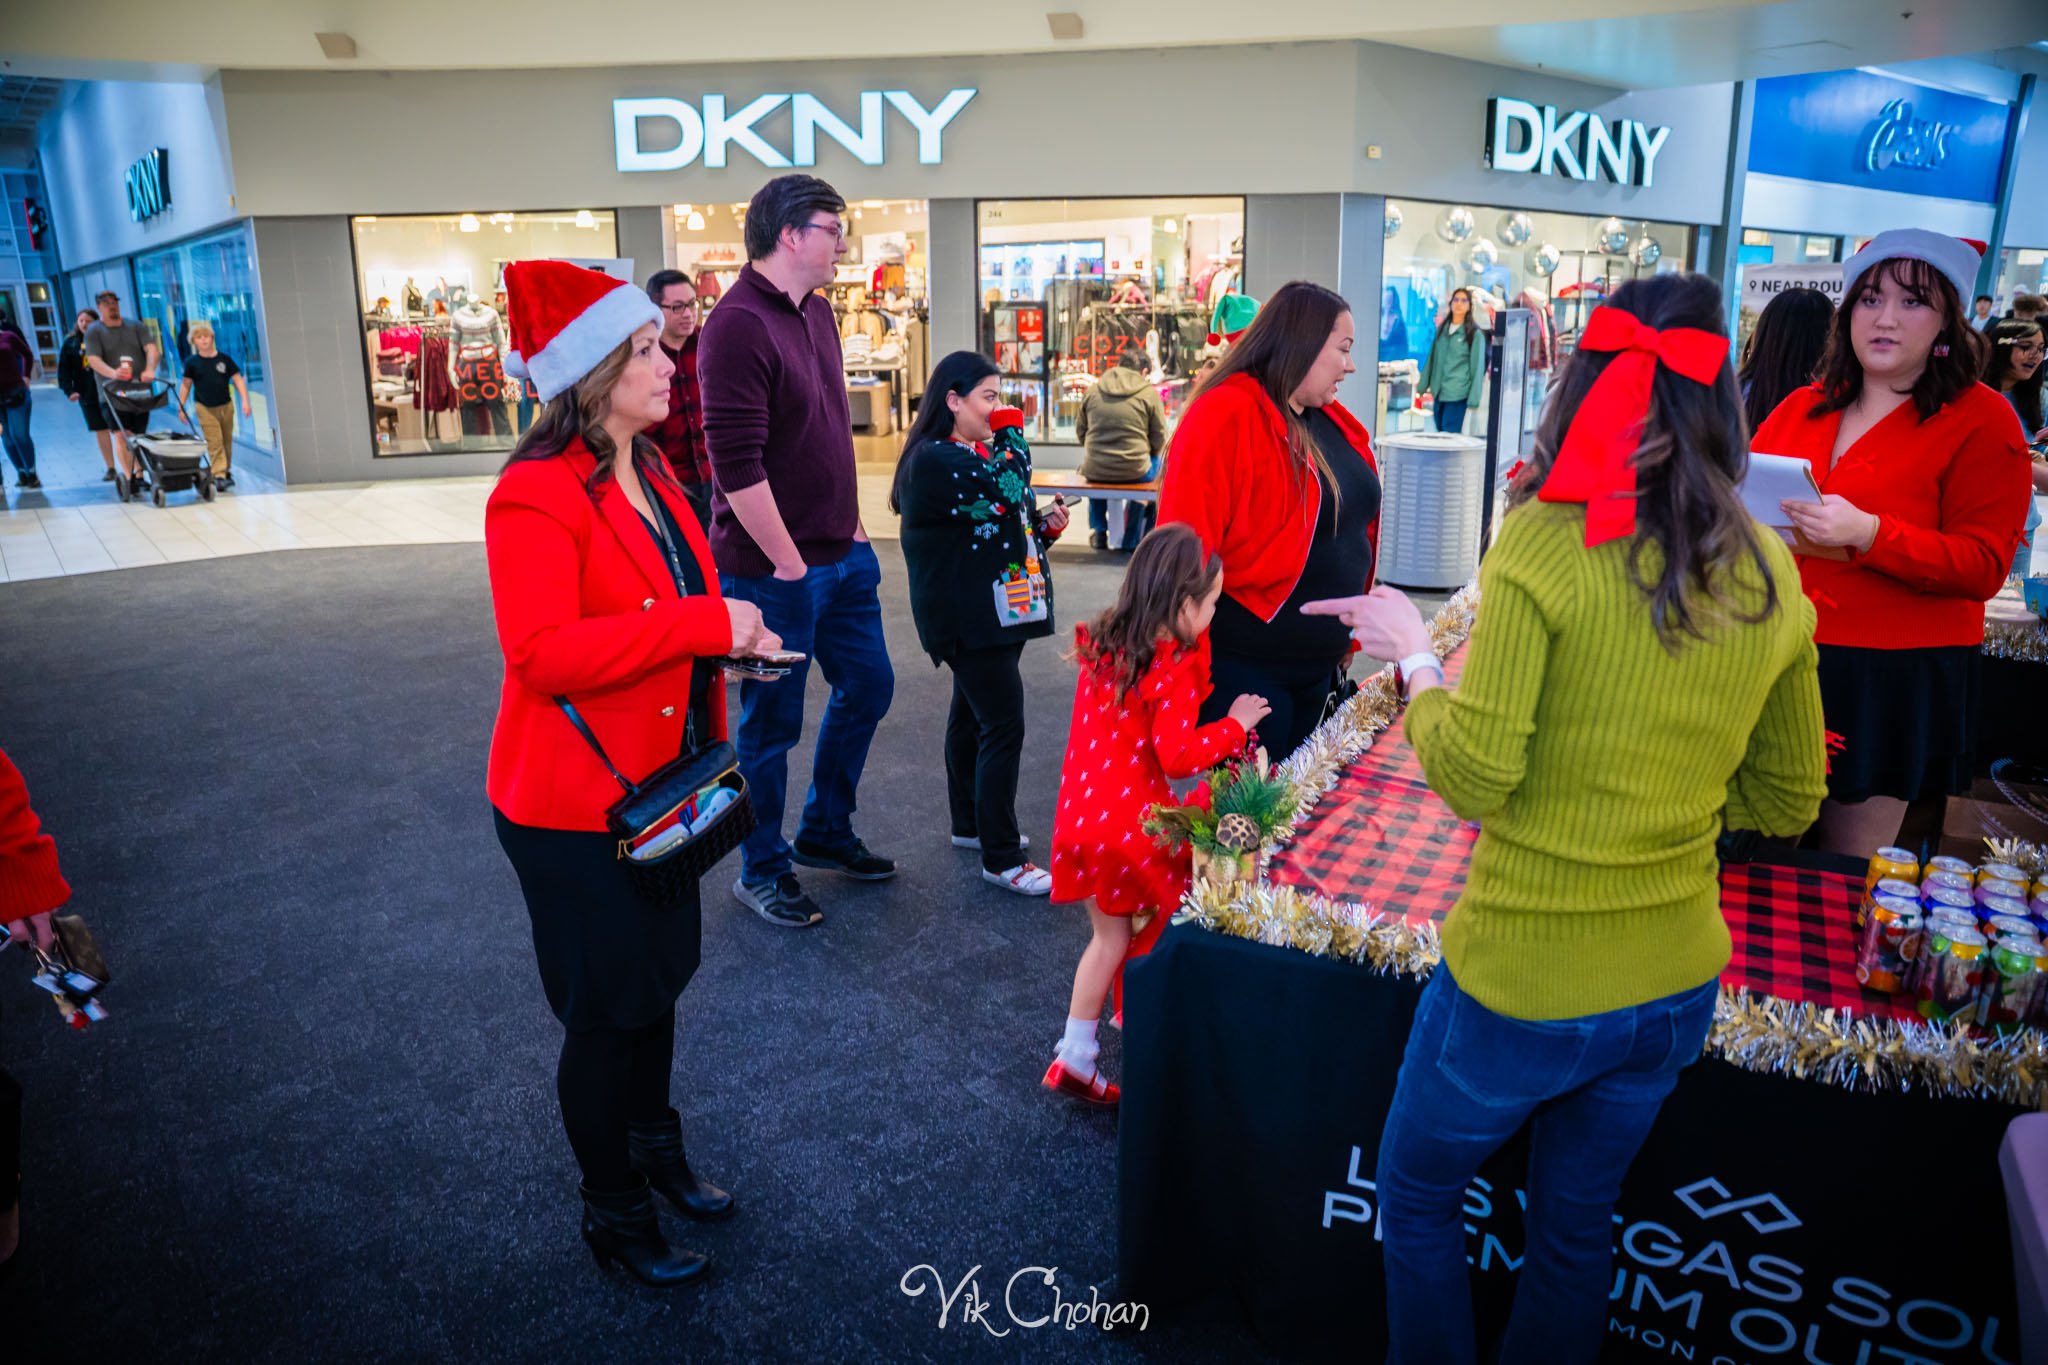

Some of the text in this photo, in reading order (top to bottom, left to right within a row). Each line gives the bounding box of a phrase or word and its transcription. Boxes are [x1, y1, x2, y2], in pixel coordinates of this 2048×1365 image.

[613, 88, 979, 172] DKNY
[1488, 97, 1672, 187] DKNY
[124, 148, 168, 222] DKNY
[1074, 335, 1147, 354] COZY
[1346, 1145, 1493, 1218] LS
